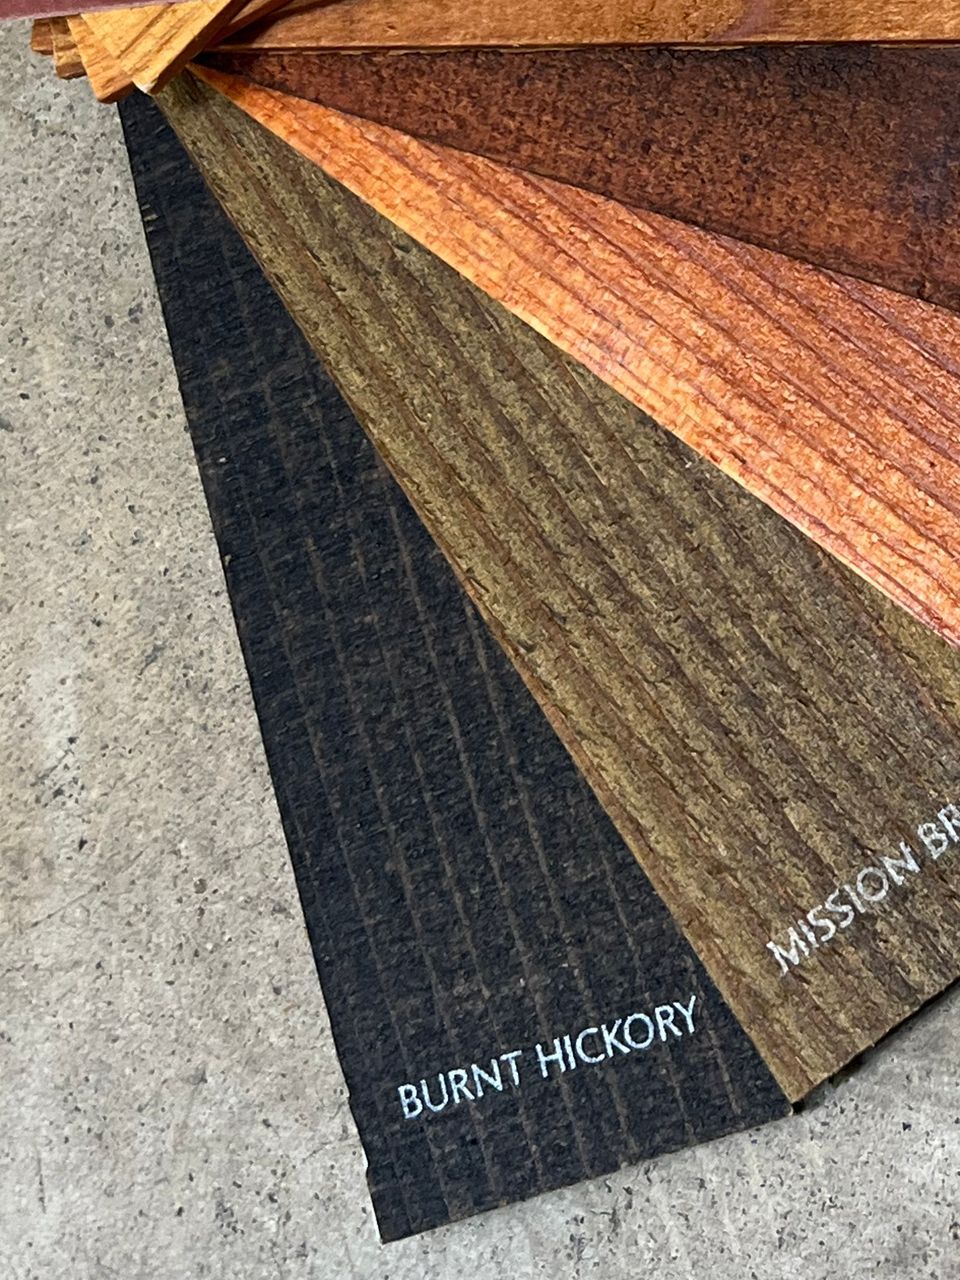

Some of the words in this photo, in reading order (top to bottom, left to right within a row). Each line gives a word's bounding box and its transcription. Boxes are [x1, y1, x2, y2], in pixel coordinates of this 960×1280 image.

[766, 841, 921, 976] MISSION
[397, 1049, 523, 1120] BURNT
[535, 995, 697, 1078] HICKORY
